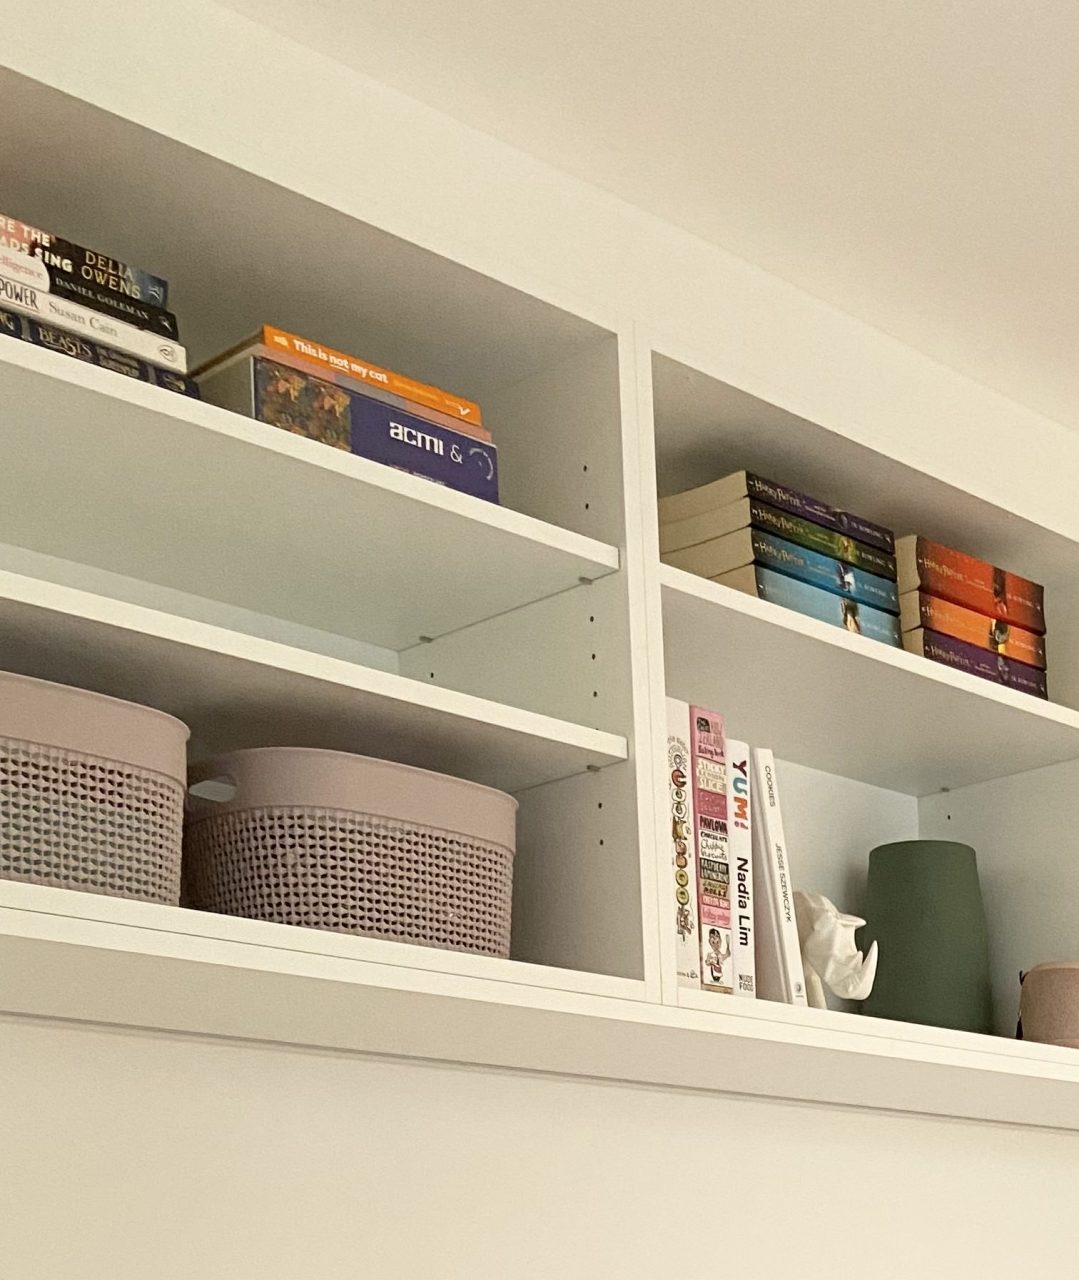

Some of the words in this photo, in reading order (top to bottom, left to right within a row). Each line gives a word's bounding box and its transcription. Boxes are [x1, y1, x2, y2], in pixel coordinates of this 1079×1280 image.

[34, 247, 72, 272] SING
[85, 250, 133, 278] DELIA
[55, 276, 96, 299] DANIEL
[97, 294, 150, 320] GOLEMAN
[81, 265, 141, 298] OWENS
[49, 301, 86, 324] Susan
[89, 316, 118, 337] Cain
[293, 339, 318, 358] This
[318, 347, 328, 361] is
[329, 355, 350, 370] not
[368, 369, 389, 384] cat
[732, 759, 750, 831] YUM!
[764, 765, 776, 808] COOKIES
[700, 815, 729, 834] PAVLOVA
[775, 842, 785, 872] JESSE
[736, 856, 750, 910] Nadia
[778, 872, 792, 924] SZEWCZYK
[738, 912, 752, 947] Lim
